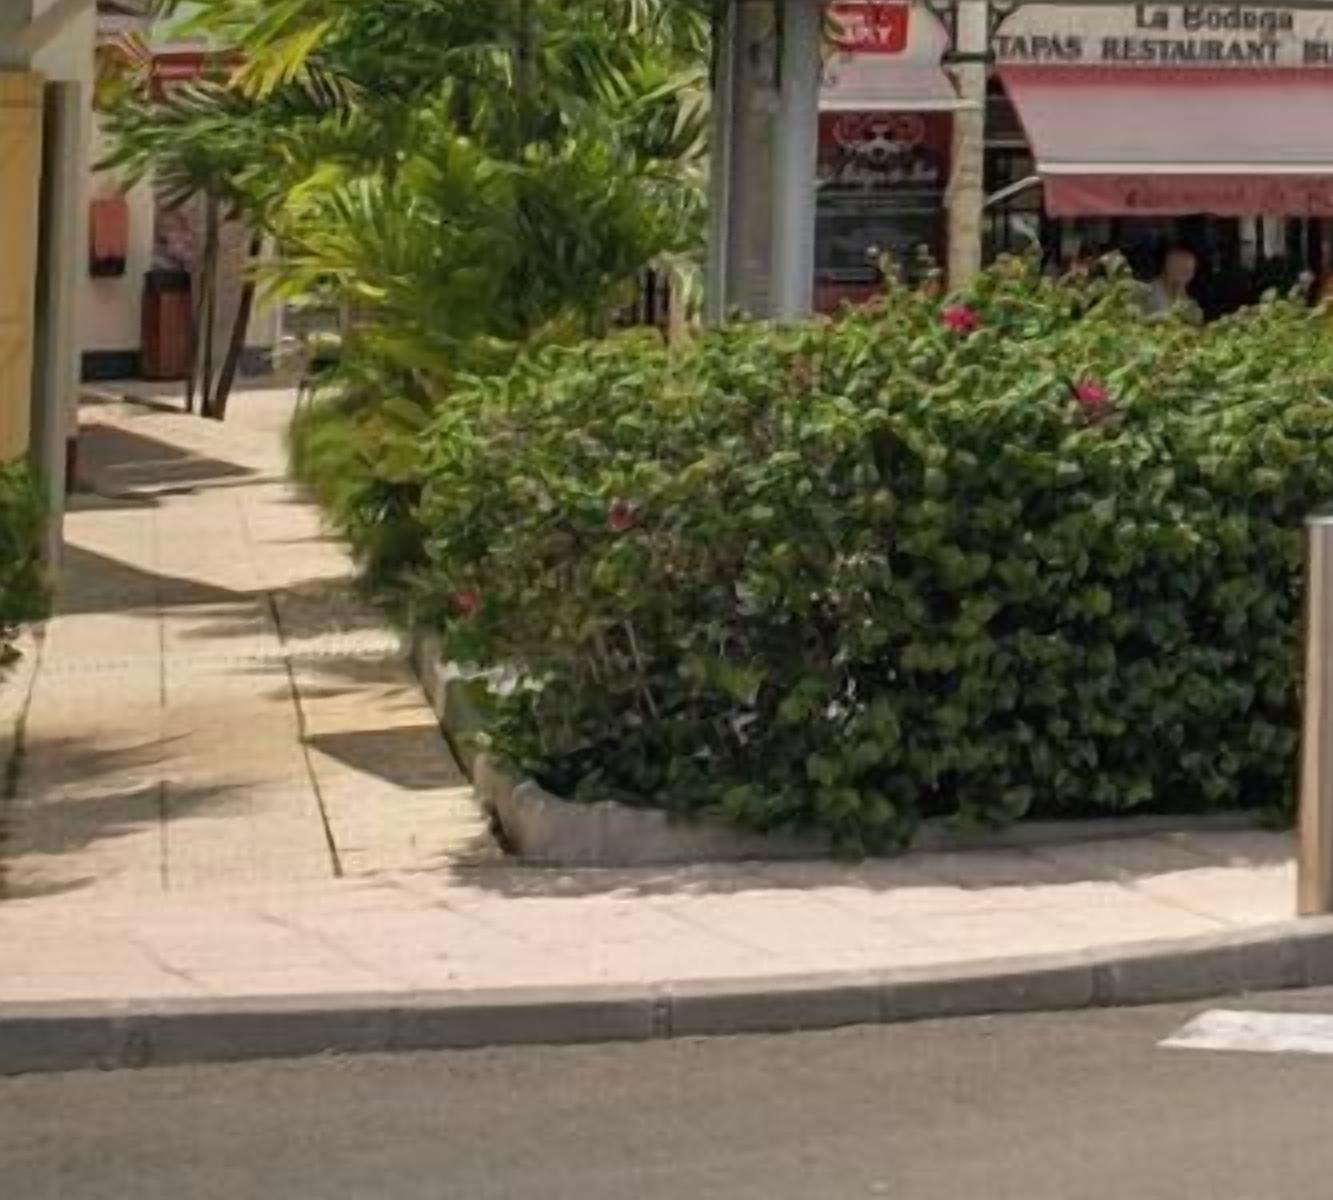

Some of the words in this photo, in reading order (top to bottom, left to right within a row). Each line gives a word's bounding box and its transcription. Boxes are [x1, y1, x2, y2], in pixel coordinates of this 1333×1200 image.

[1134, 4, 1169, 31] La
[1183, 5, 1294, 38] Bodega
[997, 34, 1083, 62] TAPAS
[1101, 35, 1281, 63] RESTAURANT
